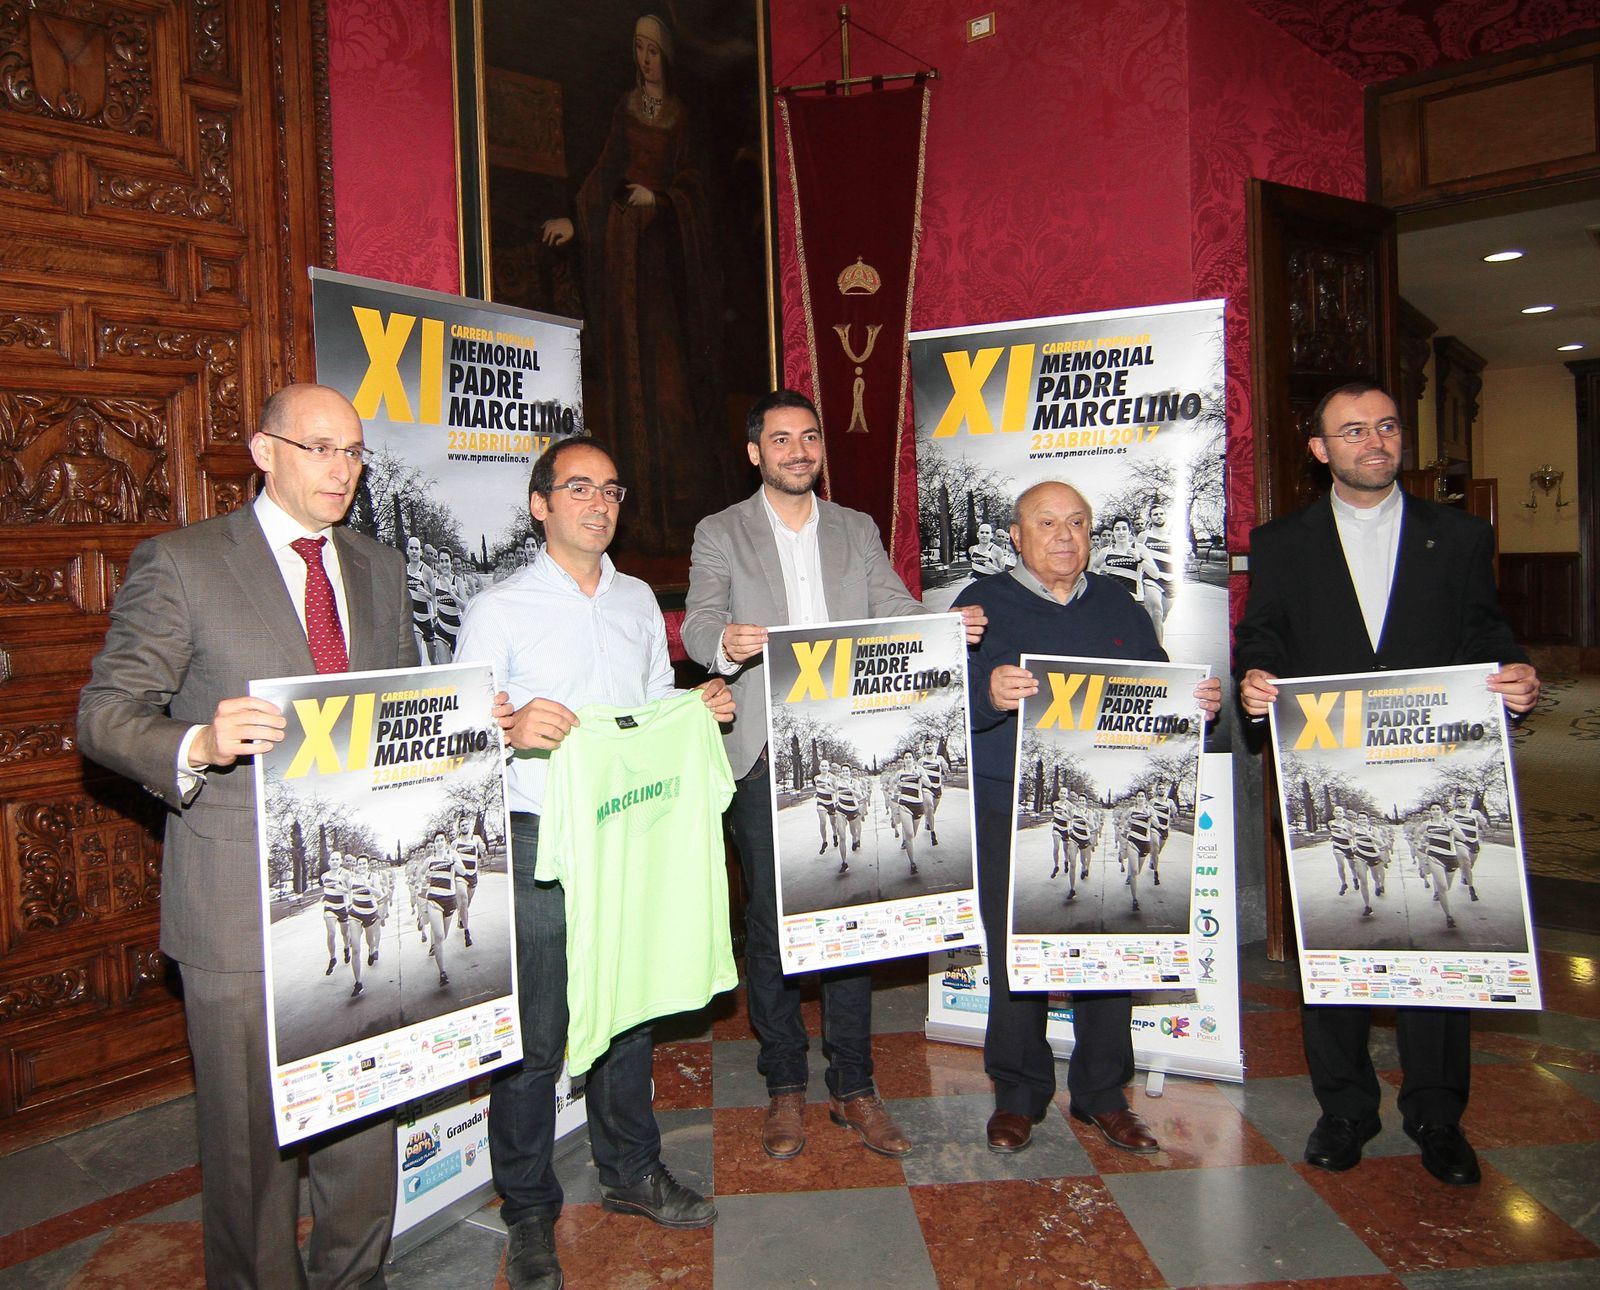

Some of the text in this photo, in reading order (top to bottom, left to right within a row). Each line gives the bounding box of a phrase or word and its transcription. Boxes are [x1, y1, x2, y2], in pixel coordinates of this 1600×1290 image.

[451, 324, 494, 342] CARRERA
[451, 339, 540, 371] MEMORIAL
[1042, 340, 1093, 354] CARRERA
[352, 305, 444, 425] XI
[1040, 345, 1154, 375] MEMORIAL
[449, 364, 523, 399] PADRE
[931, 344, 1036, 438] XI
[1036, 370, 1129, 402] PADRE
[448, 397, 574, 434] MARCELINO
[1032, 392, 1201, 430] MARCELINO
[448, 431, 550, 453] 23ABRIL2017
[1030, 426, 1160, 451] 23ABRIL2017
[448, 453, 529, 463] www.mpmarcelino.es
[1030, 446, 1127, 459] www.mpmarcelino.es
[856, 640, 923, 659] MEMORIAL
[857, 636, 887, 645] CARRERA
[785, 638, 853, 703] XI
[854, 656, 909, 677] PADRE
[853, 670, 951, 696] MARCELINO
[1106, 684, 1168, 698] MEMORIAL
[1368, 688, 1404, 697] CARRERA
[379, 695, 459, 719] MEMORIAL
[381, 690, 419, 702] CARRERA
[852, 691, 928, 709] 23ABRIL2017
[1035, 672, 1105, 731] XI
[1101, 698, 1153, 715] PADRE
[1368, 693, 1448, 711] MEMORIAL
[376, 714, 443, 743] PADRE
[1097, 715, 1189, 734] MARCELINO
[1293, 690, 1363, 751] XI
[1366, 708, 1431, 729] PADRE
[283, 693, 376, 779] XI
[1365, 723, 1484, 747] MARCELINO
[374, 730, 488, 767] MARCELINO
[372, 757, 465, 784] 23ABRIL2017
[371, 775, 444, 792] www.mpmarcelino.es
[597, 781, 663, 825] MARCELINO
[447, 1113, 482, 1139] Granada
